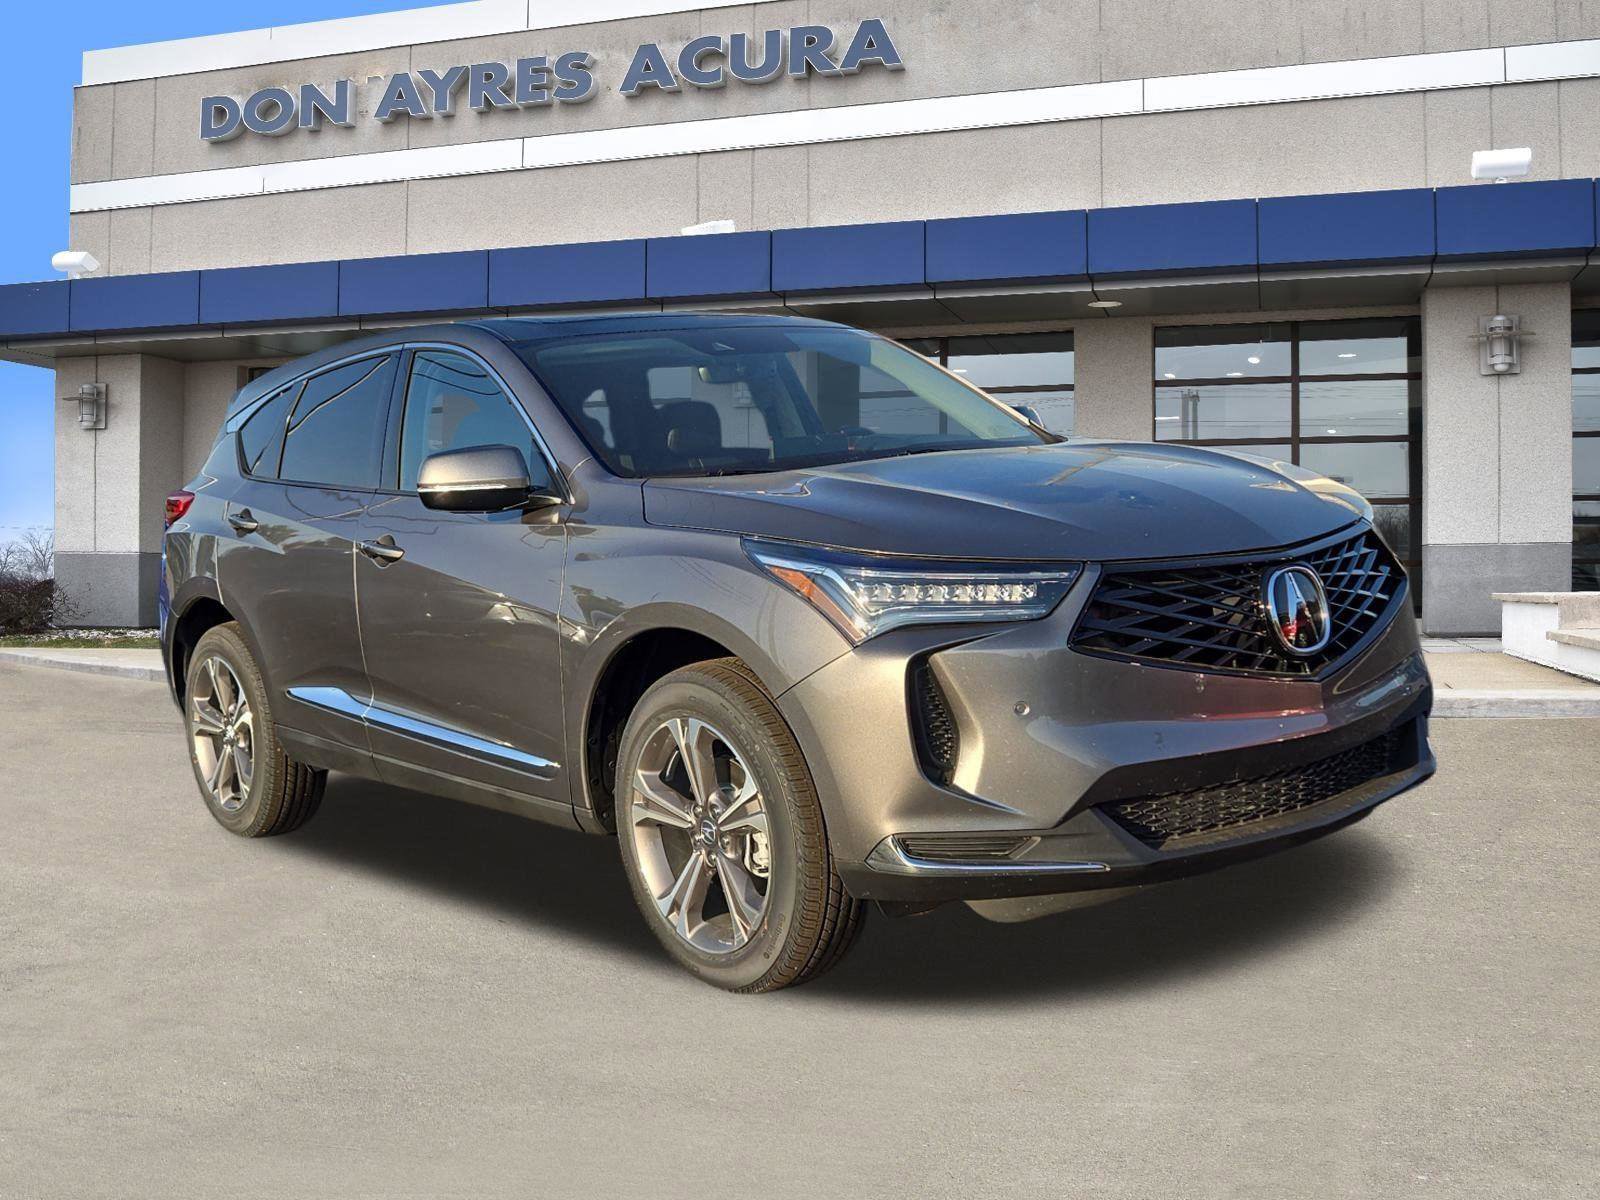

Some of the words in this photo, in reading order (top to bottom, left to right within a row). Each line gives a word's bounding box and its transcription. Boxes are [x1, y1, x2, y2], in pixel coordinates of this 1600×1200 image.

[200, 79, 353, 141] DON
[373, 51, 597, 122] AYRES
[618, 18, 904, 96] ACURA
